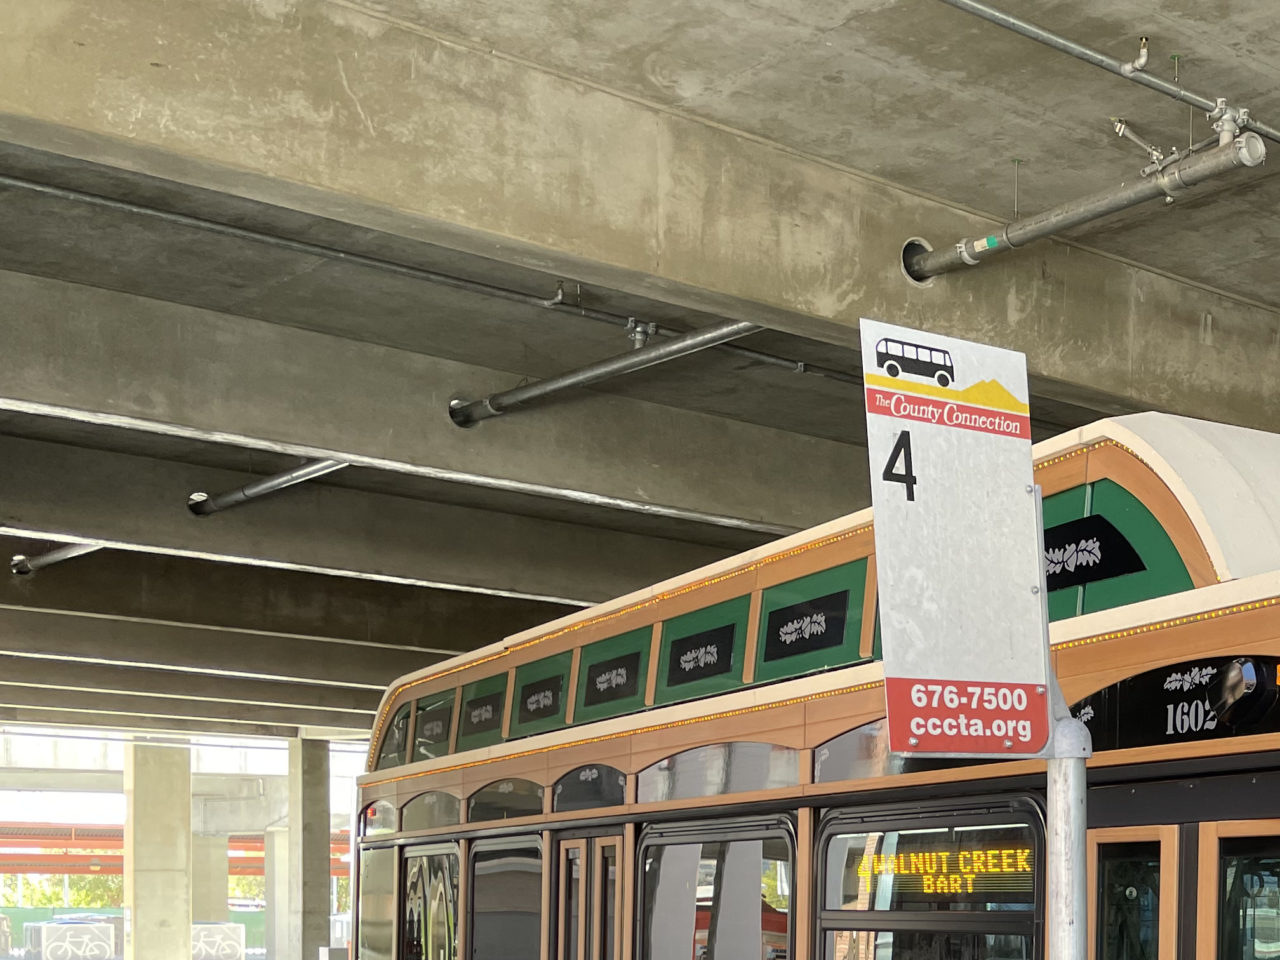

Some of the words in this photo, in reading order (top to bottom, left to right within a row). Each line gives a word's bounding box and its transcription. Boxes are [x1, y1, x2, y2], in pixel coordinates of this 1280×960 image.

[876, 394, 890, 408] The
[890, 394, 942, 423] County
[944, 404, 1020, 434] Connection
[882, 429, 917, 502] 4
[910, 684, 1028, 711] 676-7500
[910, 714, 1032, 742] cccta.org
[1165, 699, 1218, 735] 1602
[857, 855, 872, 893] 4
[872, 852, 950, 874] WALNUT
[958, 849, 1031, 873] CREEK
[922, 874, 976, 893] BART
